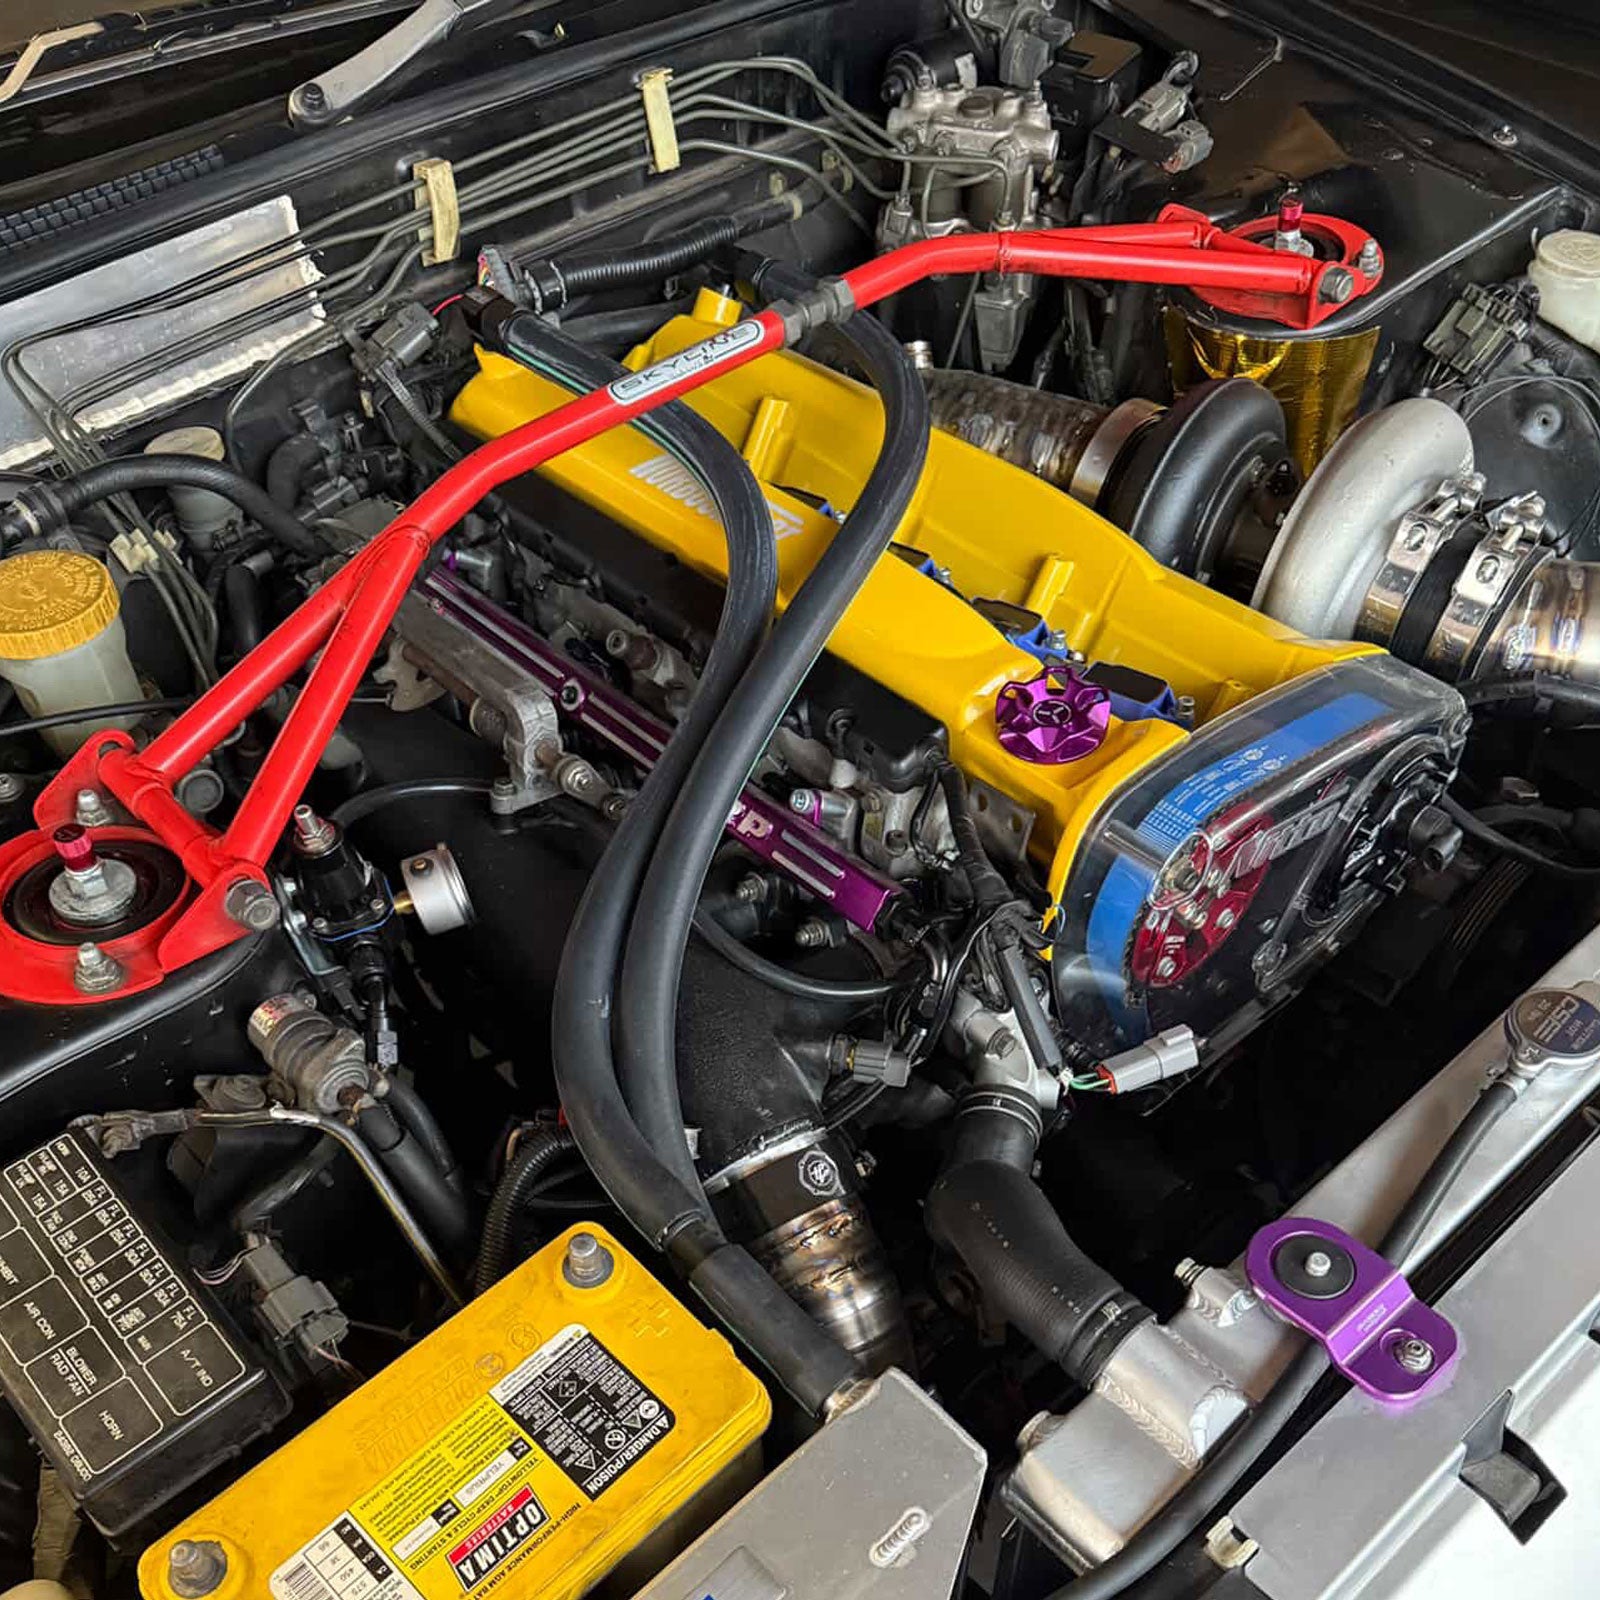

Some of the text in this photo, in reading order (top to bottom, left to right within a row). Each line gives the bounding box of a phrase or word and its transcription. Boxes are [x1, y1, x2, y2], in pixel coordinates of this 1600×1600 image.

[621, 327, 748, 389] SKYLINE
[74, 1165, 92, 1184] 10A
[94, 1184, 108, 1199] FL
[107, 1203, 122, 1218] FL
[121, 1222, 137, 1238] FL
[135, 1241, 151, 1258] FL
[150, 1261, 167, 1278] FL
[165, 1281, 181, 1298] FL
[23, 1299, 56, 1340] AIR CON
[181, 1303, 198, 1321] FL
[48, 1351, 85, 1398] RAD FAN
[65, 1345, 98, 1387] BLOWER
[97, 1408, 124, 1442] HORN
[585, 1424, 662, 1493] DANGER/POISON
[462, 1502, 516, 1550] BATTERIES
[455, 1500, 546, 1583] OPTIMA
